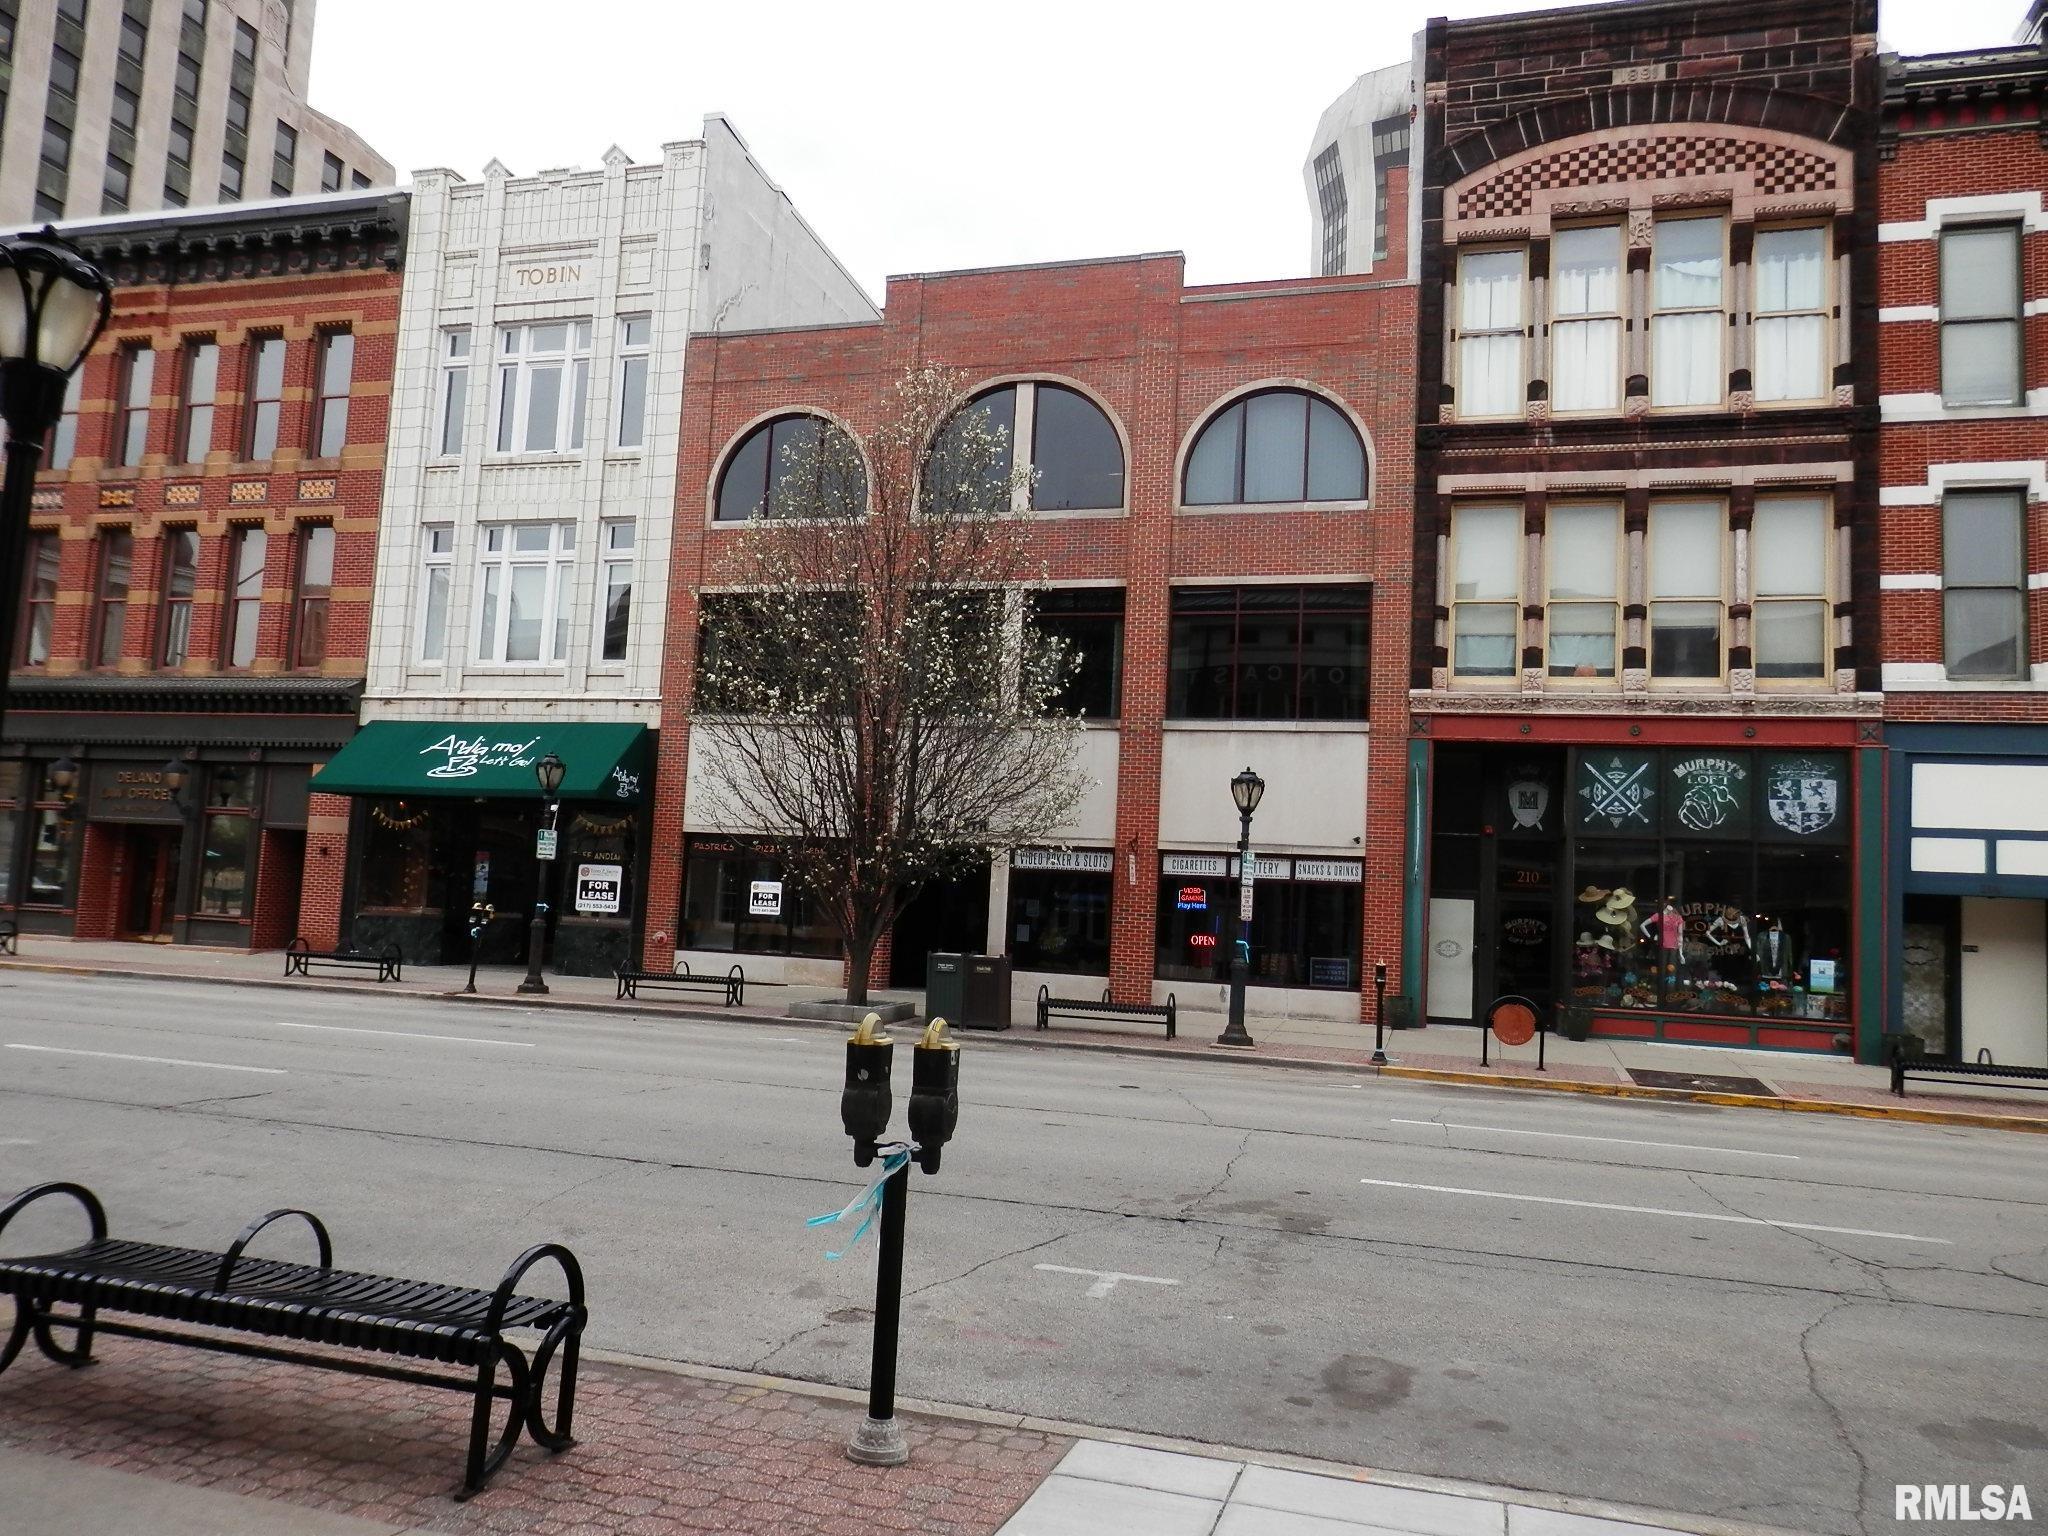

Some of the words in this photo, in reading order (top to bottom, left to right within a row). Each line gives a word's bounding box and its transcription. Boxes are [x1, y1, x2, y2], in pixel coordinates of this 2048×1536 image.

[516, 264, 582, 286] TOBIN
[116, 770, 163, 784] DELANO
[1020, 852, 1043, 865] VIDEO
[1046, 852, 1072, 866] POKER
[1074, 854, 1081, 867] &
[1083, 854, 1108, 869] SLOTS
[1172, 859, 1217, 871] CIGARETTES
[1298, 863, 1324, 875] SNACKS
[1326, 866, 1331, 876] &
[1334, 865, 1359, 877] DRINKS
[1517, 870, 1539, 882] 210
[588, 881, 610, 891] FOR
[581, 890, 615, 901] LEASE
[758, 892, 773, 900] FOR
[753, 899, 777, 907] LEASE
[1177, 902, 1191, 910] Play
[1190, 935, 1215, 946] OPEN
